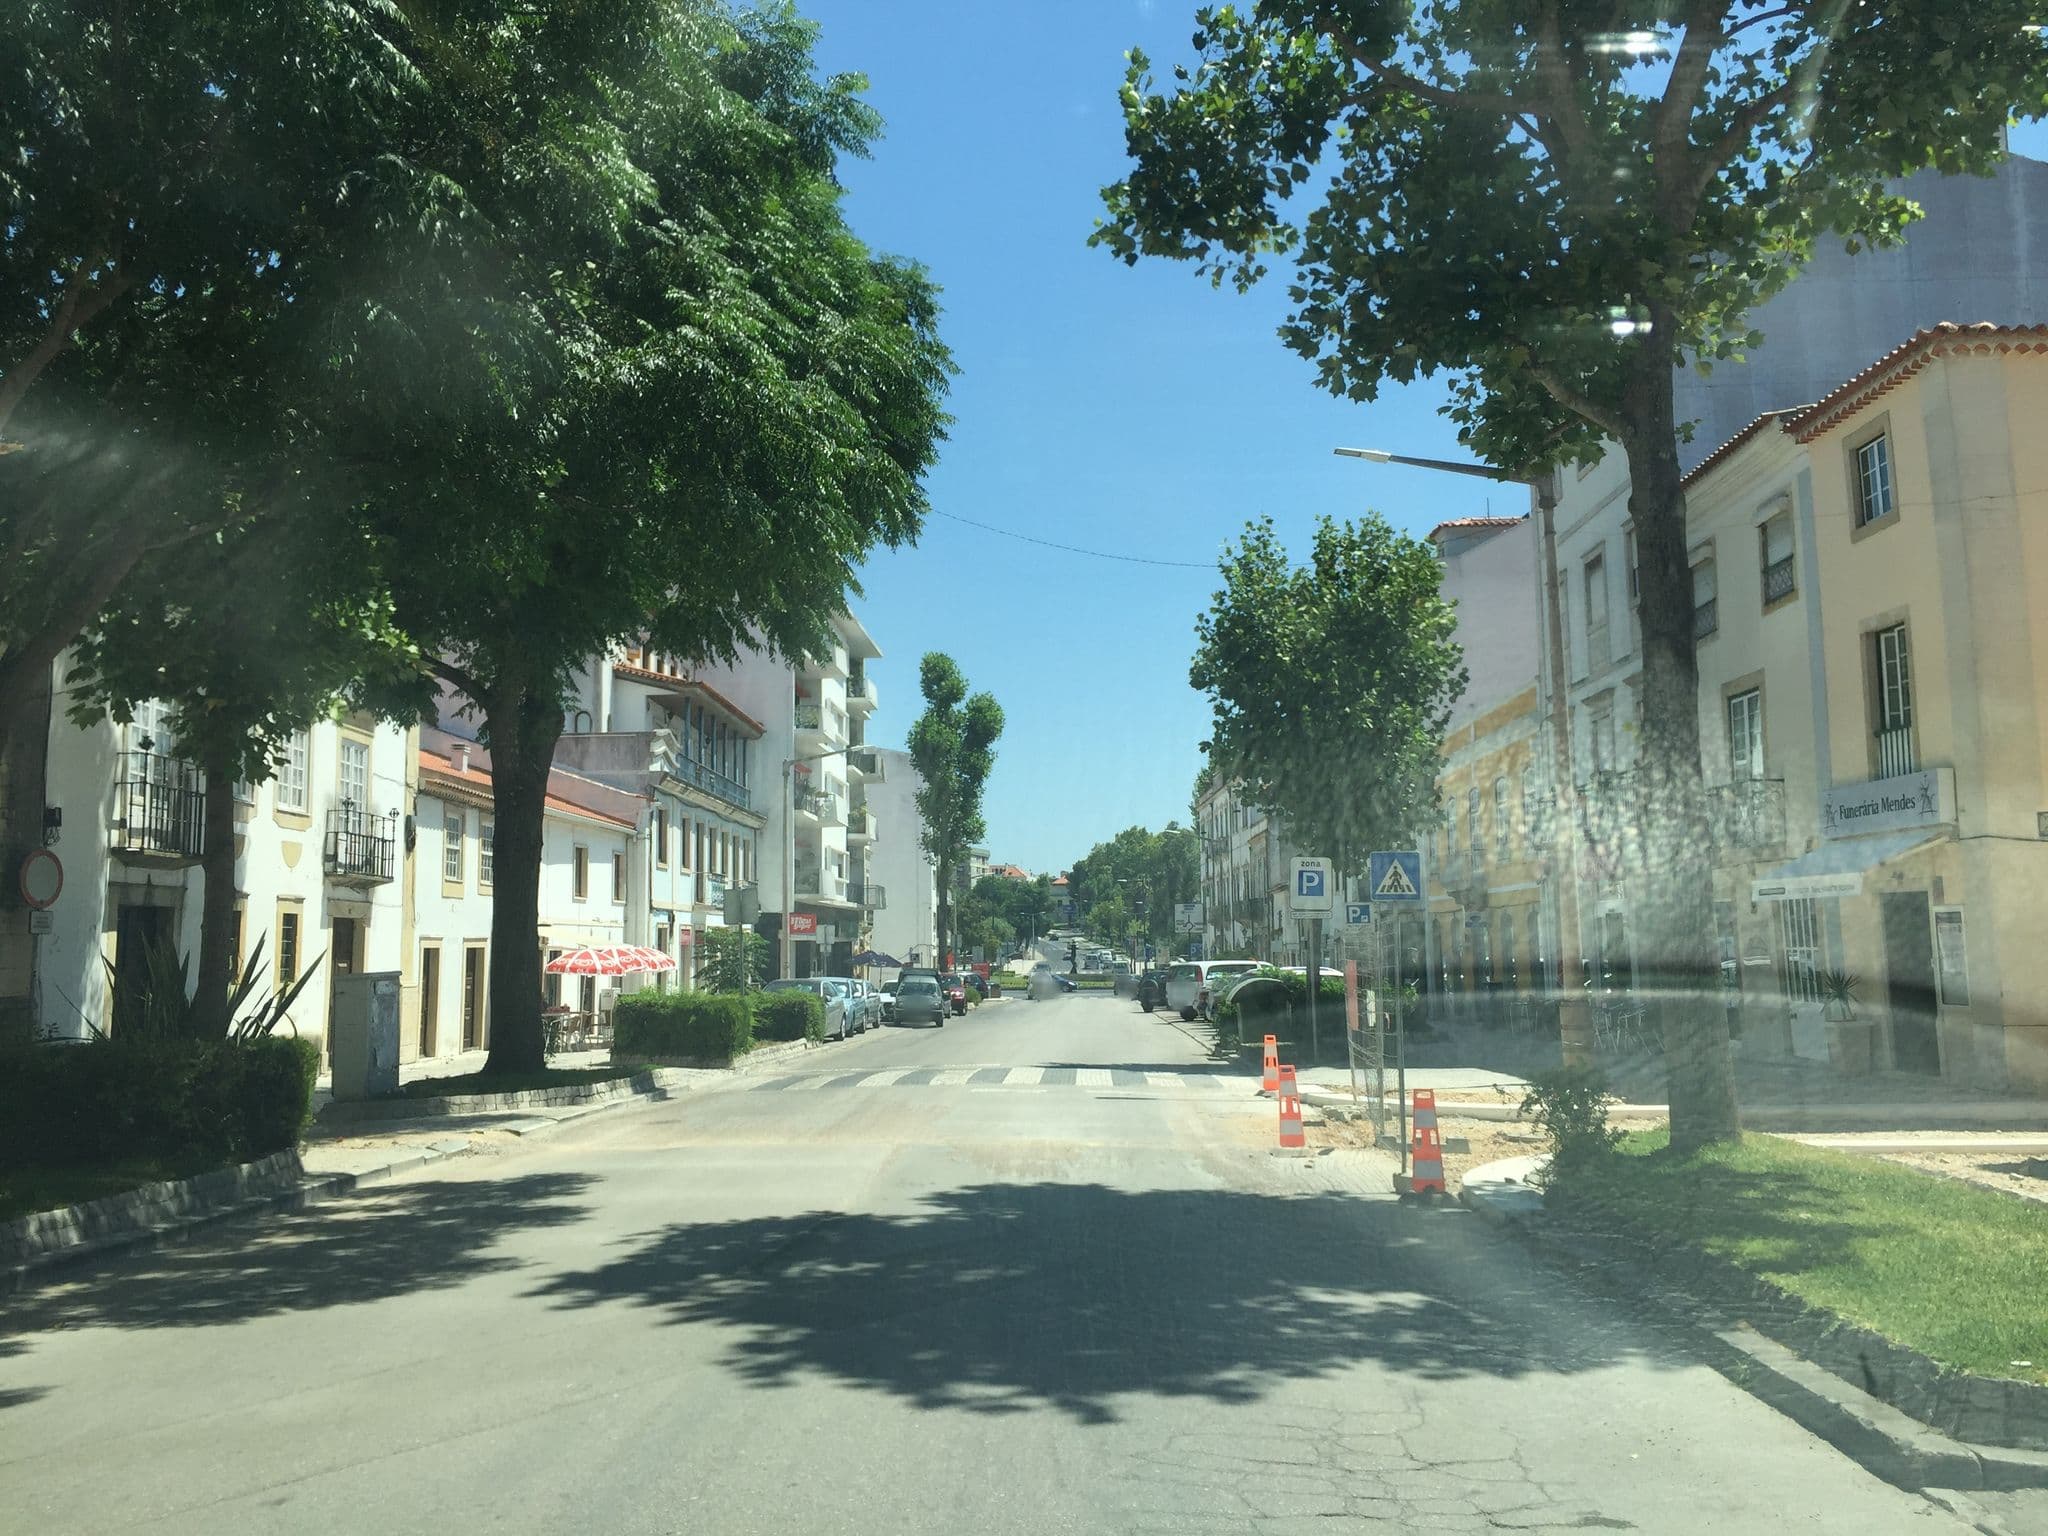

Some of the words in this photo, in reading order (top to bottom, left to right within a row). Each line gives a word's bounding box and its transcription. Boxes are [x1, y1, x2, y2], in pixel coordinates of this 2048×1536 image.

[1839, 800, 1879, 820] Funerária
[1881, 793, 1916, 813] Mendes
[1303, 872, 1319, 894] P
[1348, 907, 1360, 922] P
